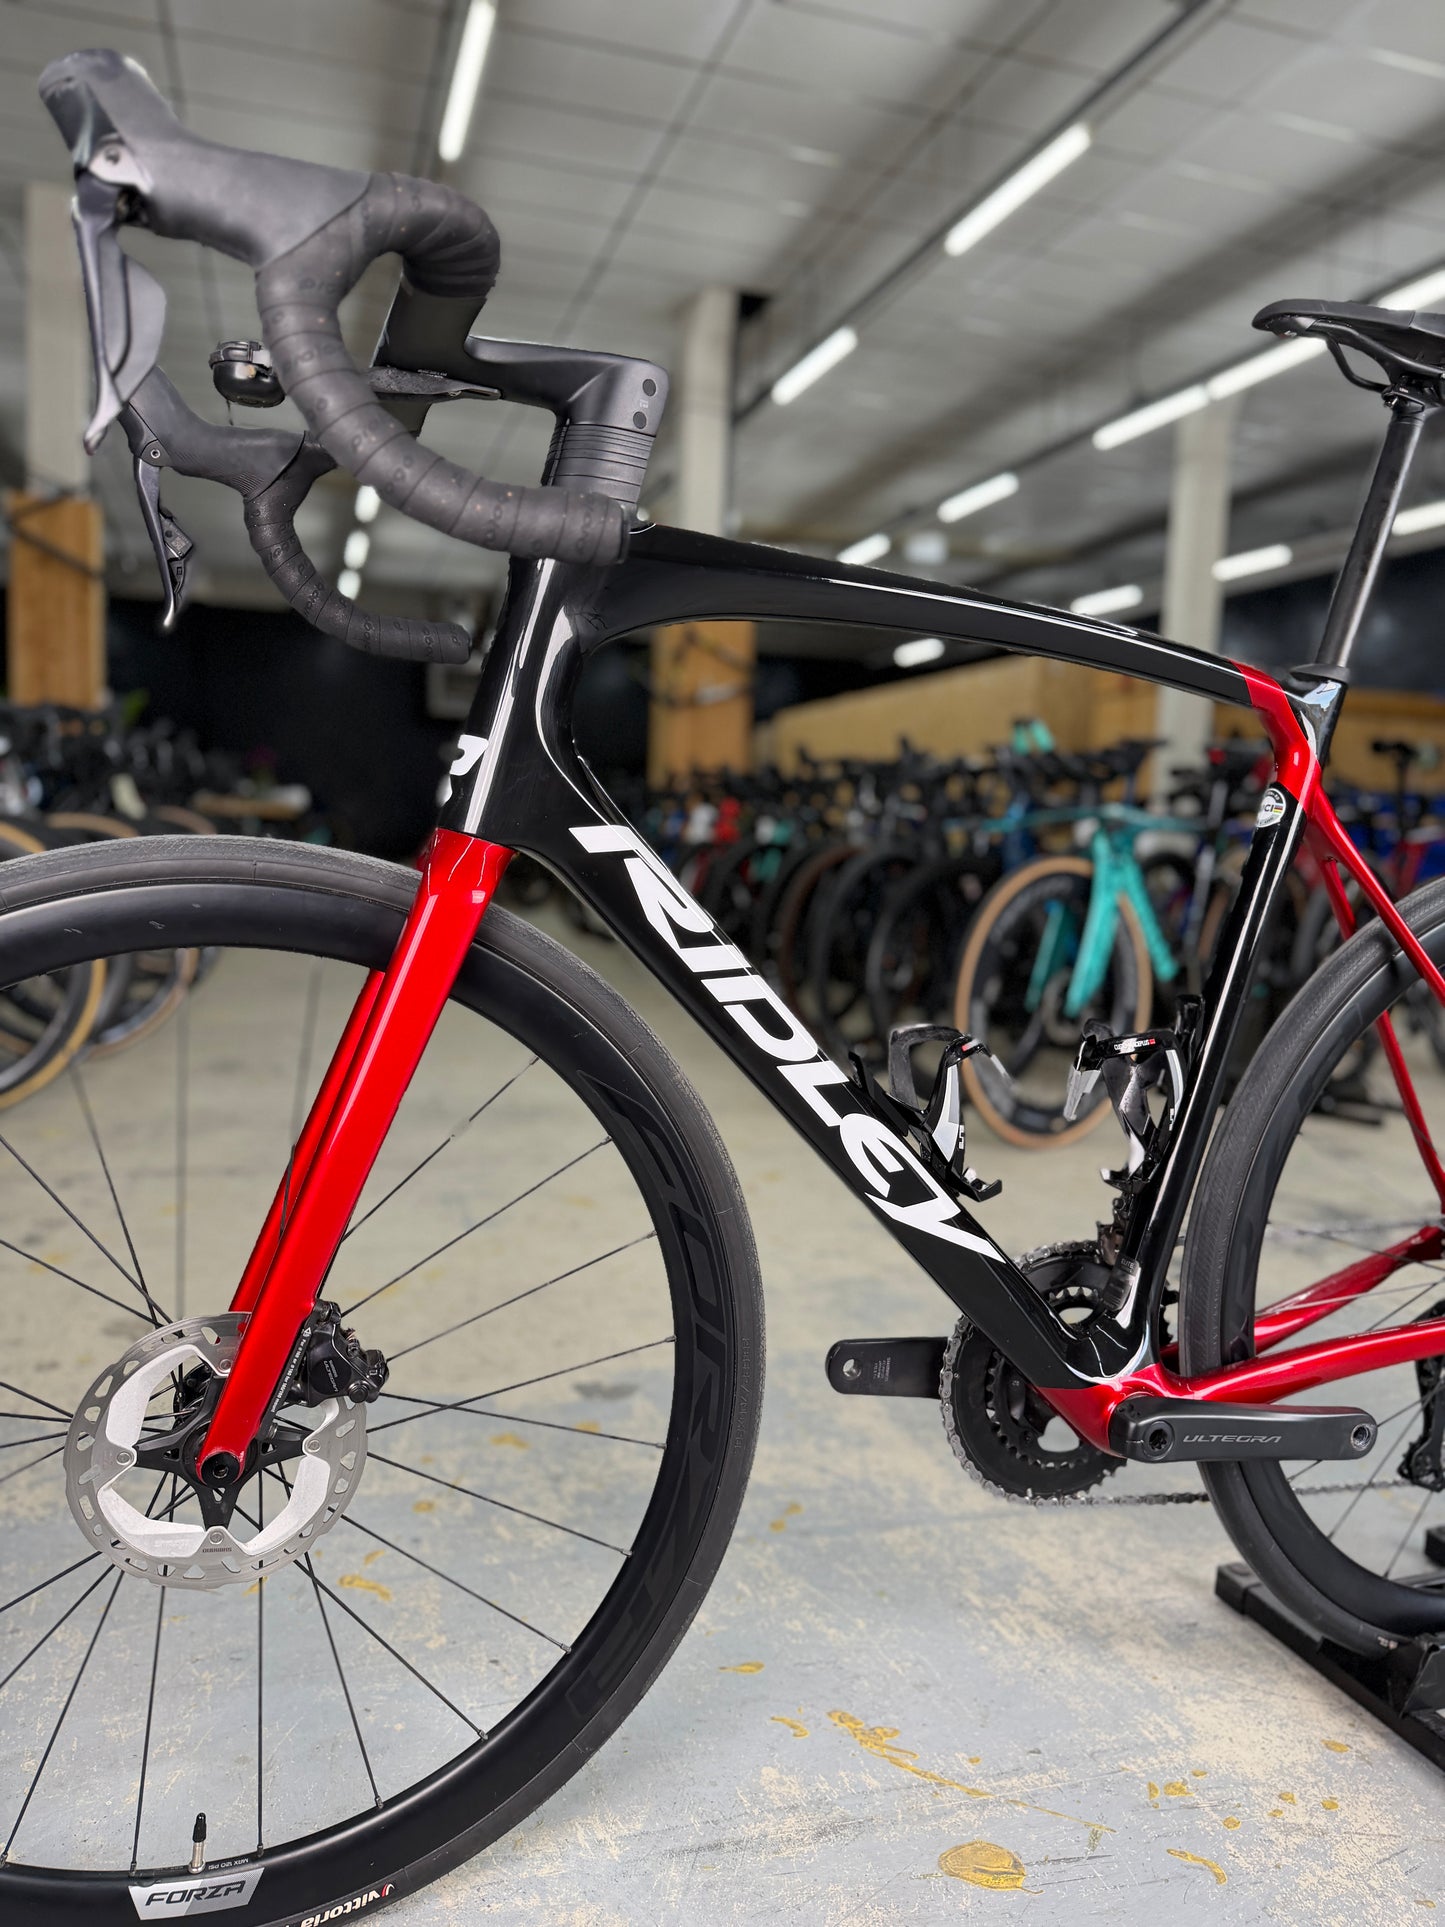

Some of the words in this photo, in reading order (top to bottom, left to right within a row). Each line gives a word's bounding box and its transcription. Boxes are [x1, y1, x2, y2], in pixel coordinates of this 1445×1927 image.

[569, 825, 1006, 1264] RIDLEY
[1183, 1434, 1283, 1443] ULTEGRA
[233, 1858, 249, 1866] MAX
[144, 1879, 247, 1907] FORZA
[301, 1890, 381, 1927] vittoria
